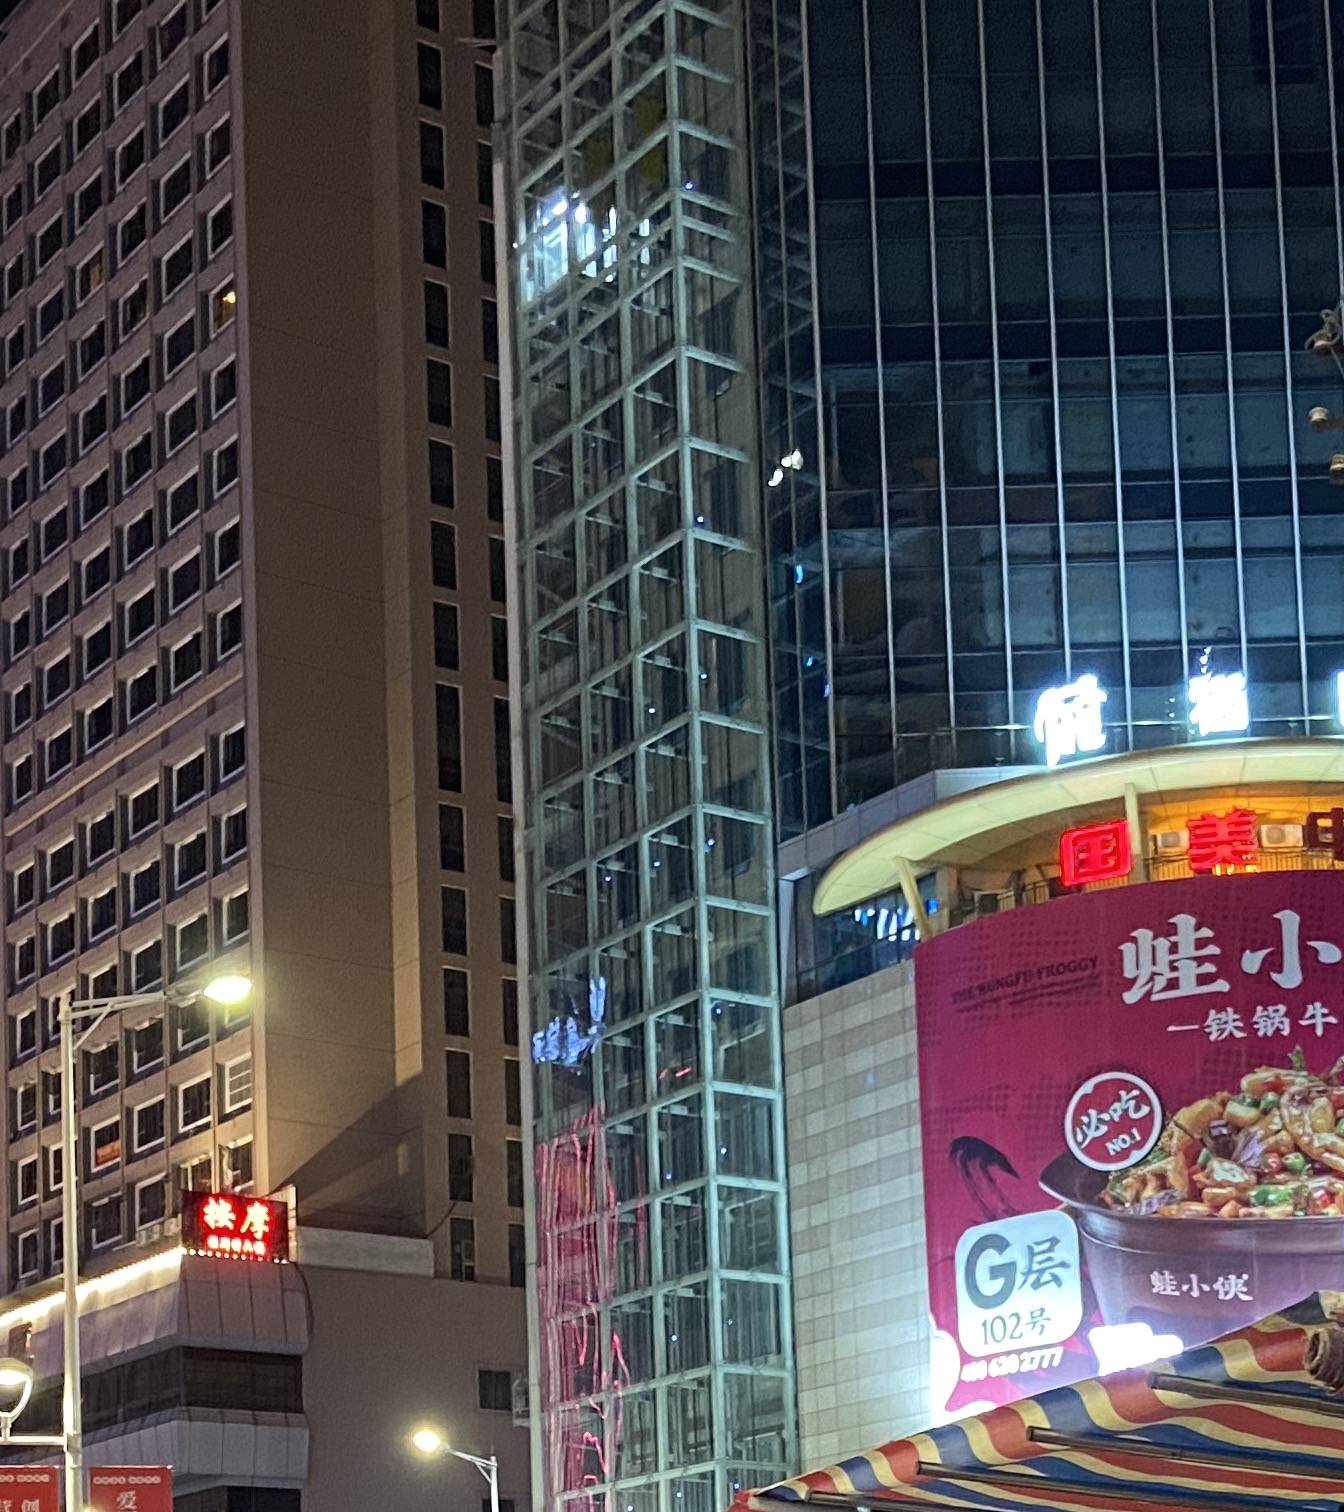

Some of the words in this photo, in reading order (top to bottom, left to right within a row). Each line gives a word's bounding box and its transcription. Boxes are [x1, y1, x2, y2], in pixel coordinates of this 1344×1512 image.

[1076, 1089, 1150, 1149] 必吃
[1105, 1127, 1141, 1156] NO.1
[203, 1197, 270, 1240] 按摩
[964, 1234, 1072, 1310] G层
[1150, 1270, 1254, 1301] 蛙小侠
[981, 1306, 1052, 1346] 102号
